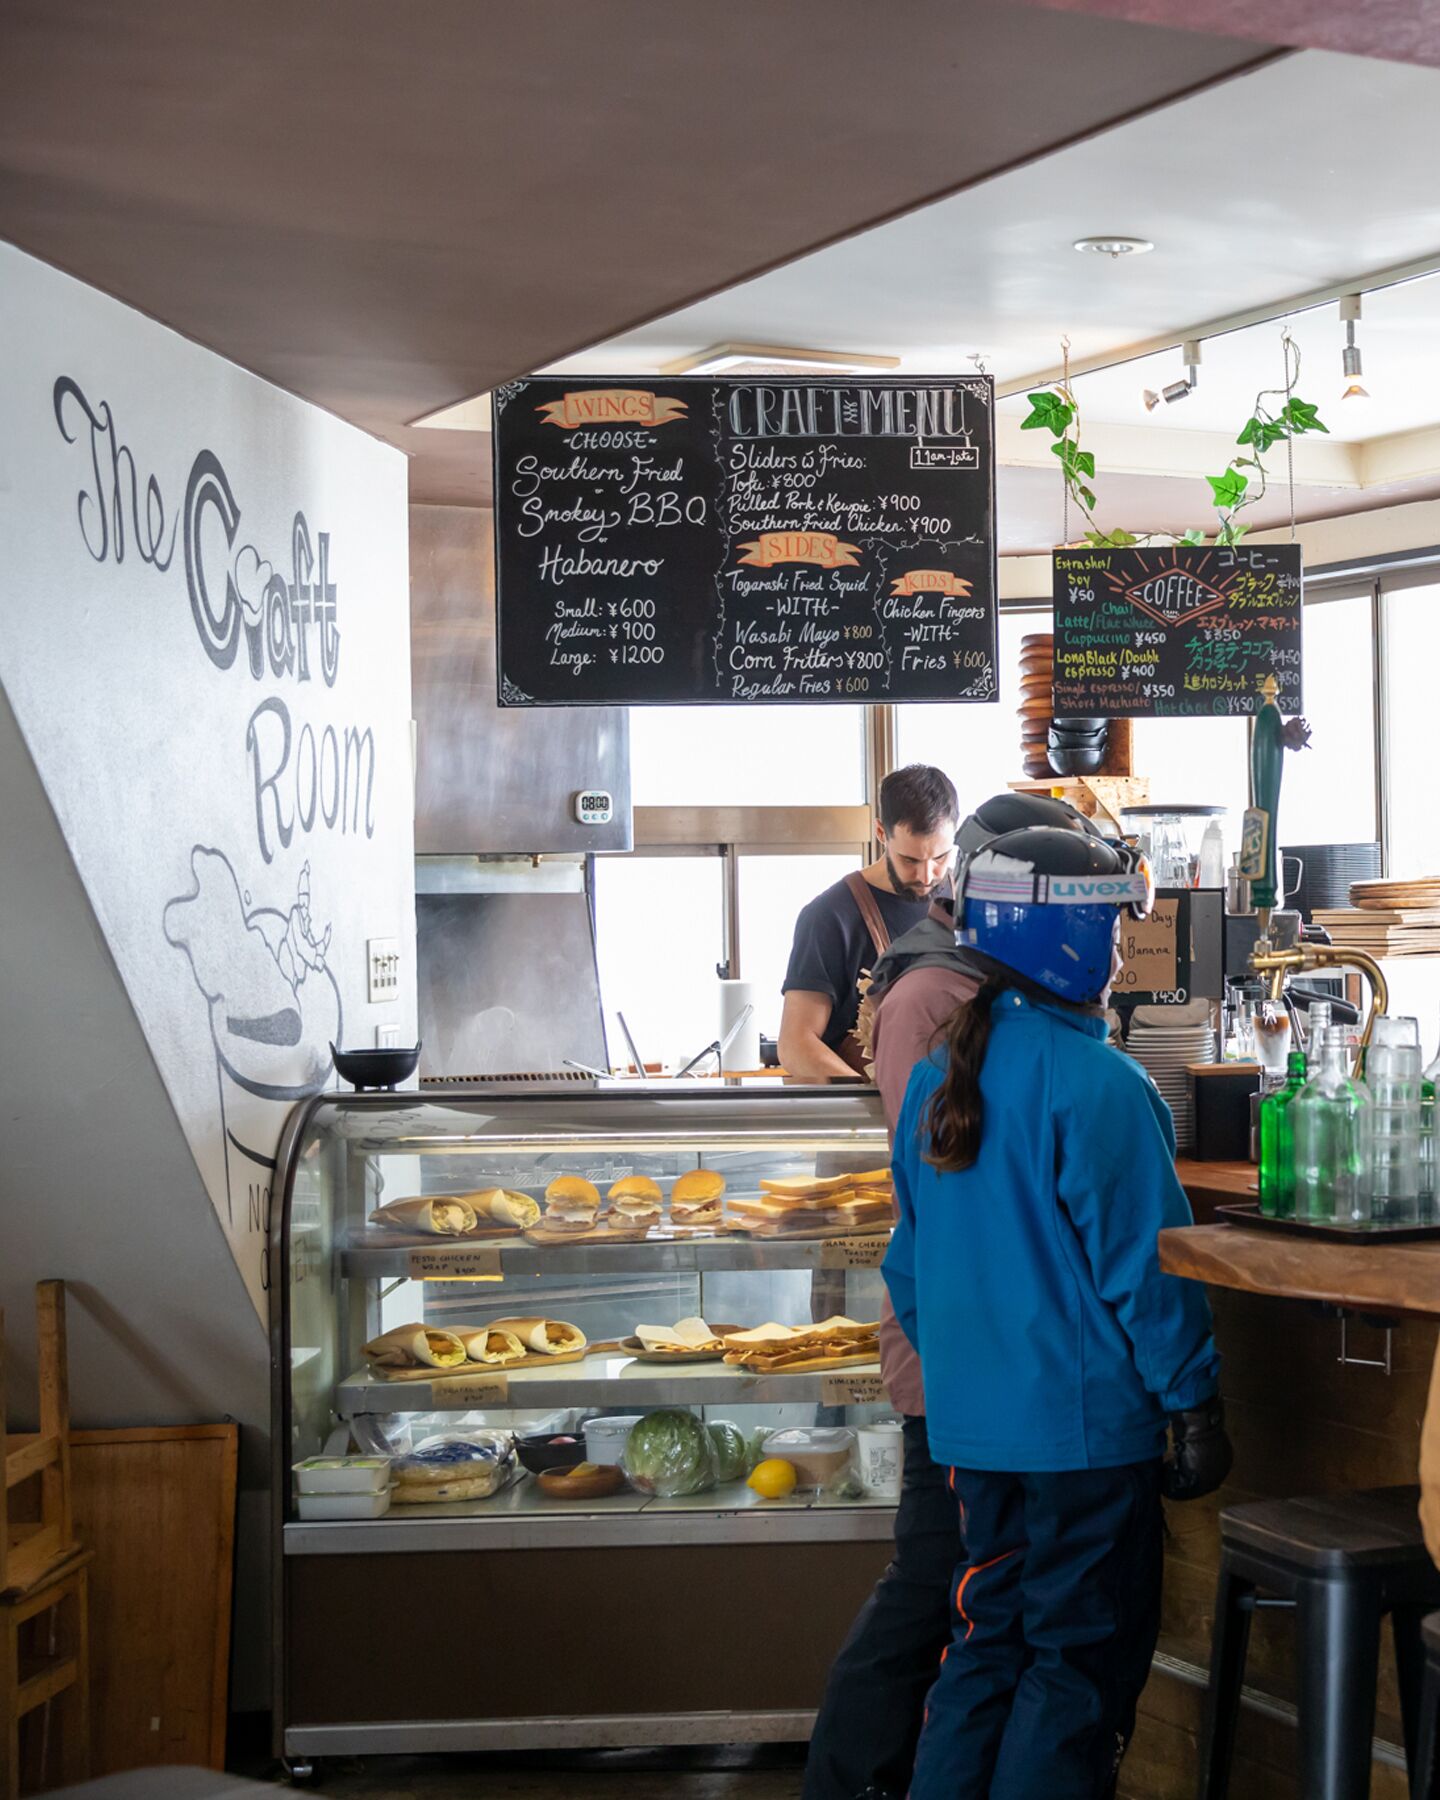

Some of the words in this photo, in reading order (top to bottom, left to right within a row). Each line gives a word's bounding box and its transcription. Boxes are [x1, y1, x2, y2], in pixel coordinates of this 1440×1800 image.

[575, 395, 652, 417] WINGS
[729, 387, 850, 437] CRAFT
[857, 389, 973, 436] MENU
[729, 444, 797, 470] Sliders
[53, 376, 179, 572] The
[512, 456, 624, 496] Southern
[620, 456, 683, 493] Fried
[772, 473, 817, 488] ¥800
[728, 492, 780, 514] Pulled
[786, 493, 816, 511] Pork
[878, 495, 921, 511] ¥900
[518, 497, 621, 543] Smokey
[729, 513, 801, 534] Southern
[801, 513, 842, 532] Fried
[910, 517, 951, 534] ¥900
[769, 539, 834, 559] SIDES
[1218, 550, 1279, 569] コーヒー
[183, 449, 340, 688] Craft
[539, 544, 664, 585] Habanero
[725, 569, 789, 597] Togarashi
[793, 570, 824, 592] Fried
[829, 570, 871, 598] Squid
[909, 574, 947, 588] KIDS
[1067, 573, 1091, 589] Soy
[1068, 587, 1095, 604] ¥50
[608, 600, 655, 618] ¥600
[883, 596, 936, 619] Chicken
[939, 597, 985, 624] Fingers
[610, 622, 655, 641] ¥900
[736, 620, 792, 644] Wasabi
[799, 622, 840, 648] Mayo
[843, 625, 873, 638] ¥800
[1065, 630, 1131, 648] Cappuccino
[1135, 631, 1167, 648] ¥450
[610, 645, 664, 664] ¥1200
[729, 645, 776, 670] Corn
[783, 645, 844, 670] Fritters
[847, 652, 883, 670] ¥800
[902, 646, 947, 671] Fries
[953, 650, 985, 668] ¥600
[1065, 666, 1116, 681] espresso
[1121, 664, 1156, 680] ¥400
[732, 673, 796, 700] Regular
[799, 676, 831, 694] Fries
[836, 677, 869, 693] ¥600
[1054, 681, 1087, 699] Single
[1143, 683, 1175, 698] ¥350
[1053, 881, 1132, 897] uvex
[1128, 936, 1171, 959] Banana
[1152, 988, 1187, 1003] ¥450
